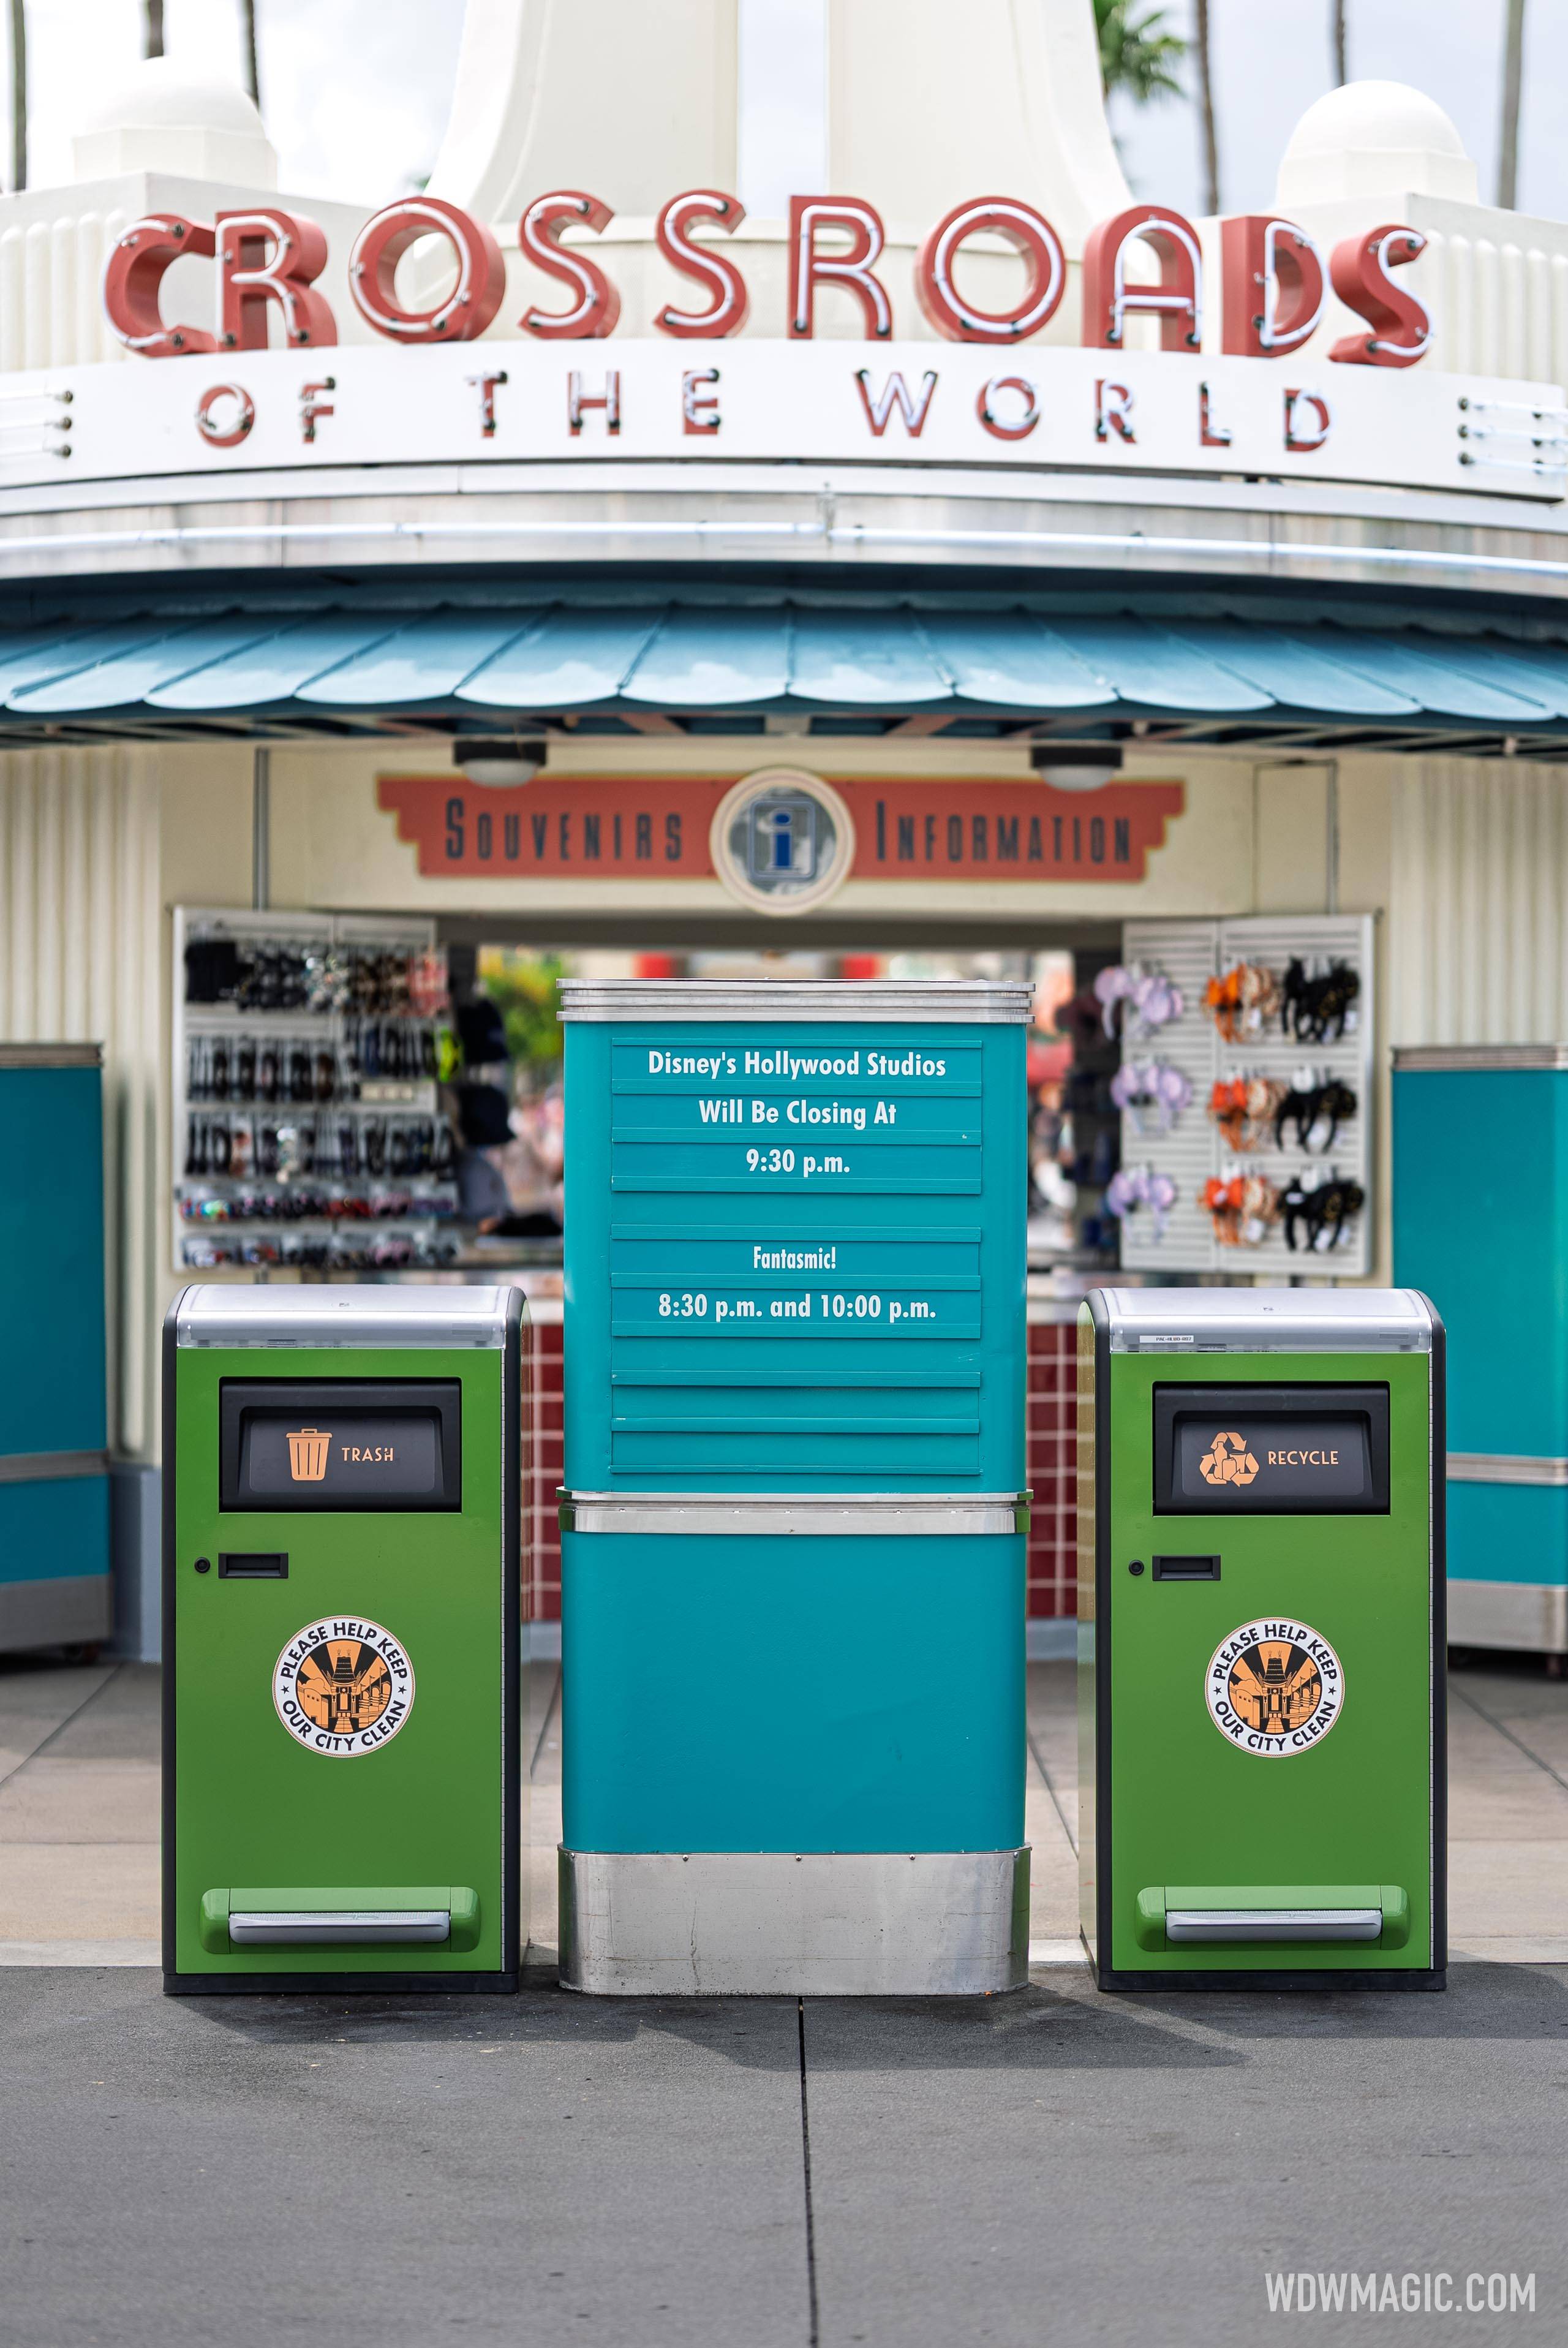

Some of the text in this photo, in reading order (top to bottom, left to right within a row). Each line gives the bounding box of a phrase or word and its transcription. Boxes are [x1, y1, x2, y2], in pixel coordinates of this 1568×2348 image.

[101, 189, 1436, 369] CROSSROADS
[195, 368, 1333, 452] OF THE WORLD
[445, 796, 682, 861] SOUVENIRS
[875, 799, 1131, 864] INFORMATION
[648, 1050, 946, 1080] Disney's Hollywood Studios
[699, 1099, 896, 1130] Will Be Closing At
[746, 1148, 851, 1177] 9:30 p.m.
[753, 1245, 837, 1270] Fantasmic!
[658, 1293, 936, 1323] 8:30 p.m. and 10:00 p.m.
[342, 1447, 394, 1462] TRASH
[1268, 1450, 1339, 1466] RECYCLE
[280, 1622, 408, 1679] PLEASE HELP KEEP
[1213, 1623, 1337, 1680] PLEASE HELP KEEP
[282, 1700, 406, 1751] OUR CITY CLEAN
[1215, 1701, 1336, 1751] OUR CITY CLEAN
